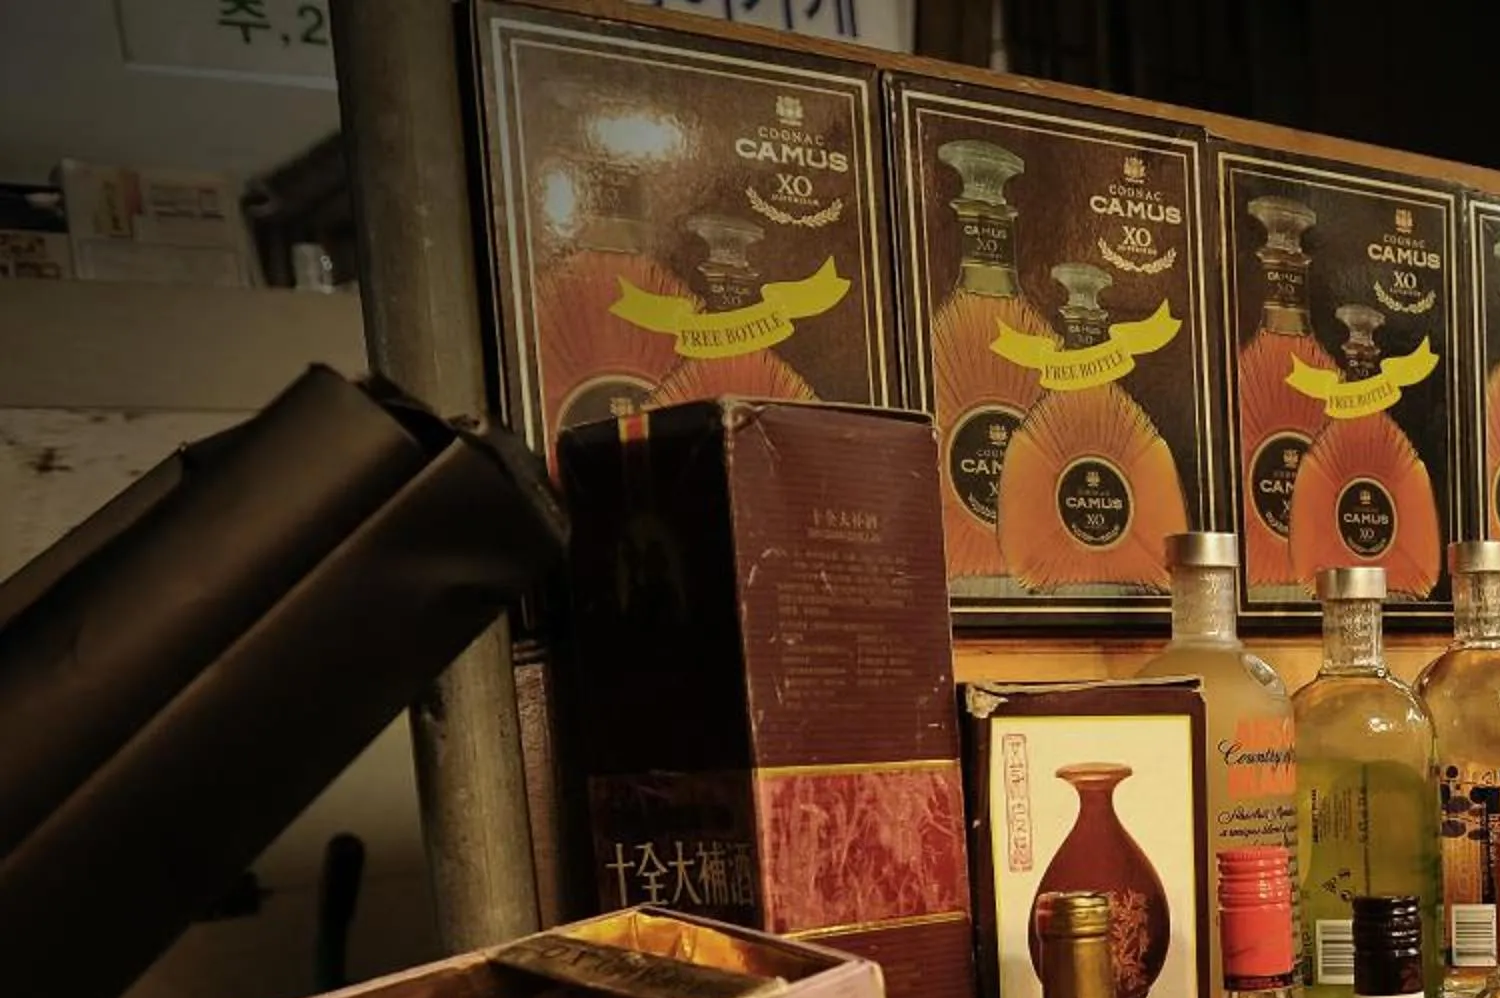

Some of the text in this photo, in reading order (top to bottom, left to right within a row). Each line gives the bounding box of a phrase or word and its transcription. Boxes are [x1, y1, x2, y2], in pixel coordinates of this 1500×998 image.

[757, 125, 825, 147] COGNAC
[735, 138, 849, 173] CAMUS
[776, 173, 813, 198] XO
[1089, 194, 1183, 225] CAMUS
[1121, 224, 1152, 247] XO
[1367, 242, 1442, 270] CAMUS
[1393, 270, 1418, 290] XO
[680, 313, 785, 349] FREE BOTTLE
[1043, 361, 1078, 381] FREE
[1064, 496, 1124, 512] CAMUS
[1342, 511, 1390, 526] CAMUS
